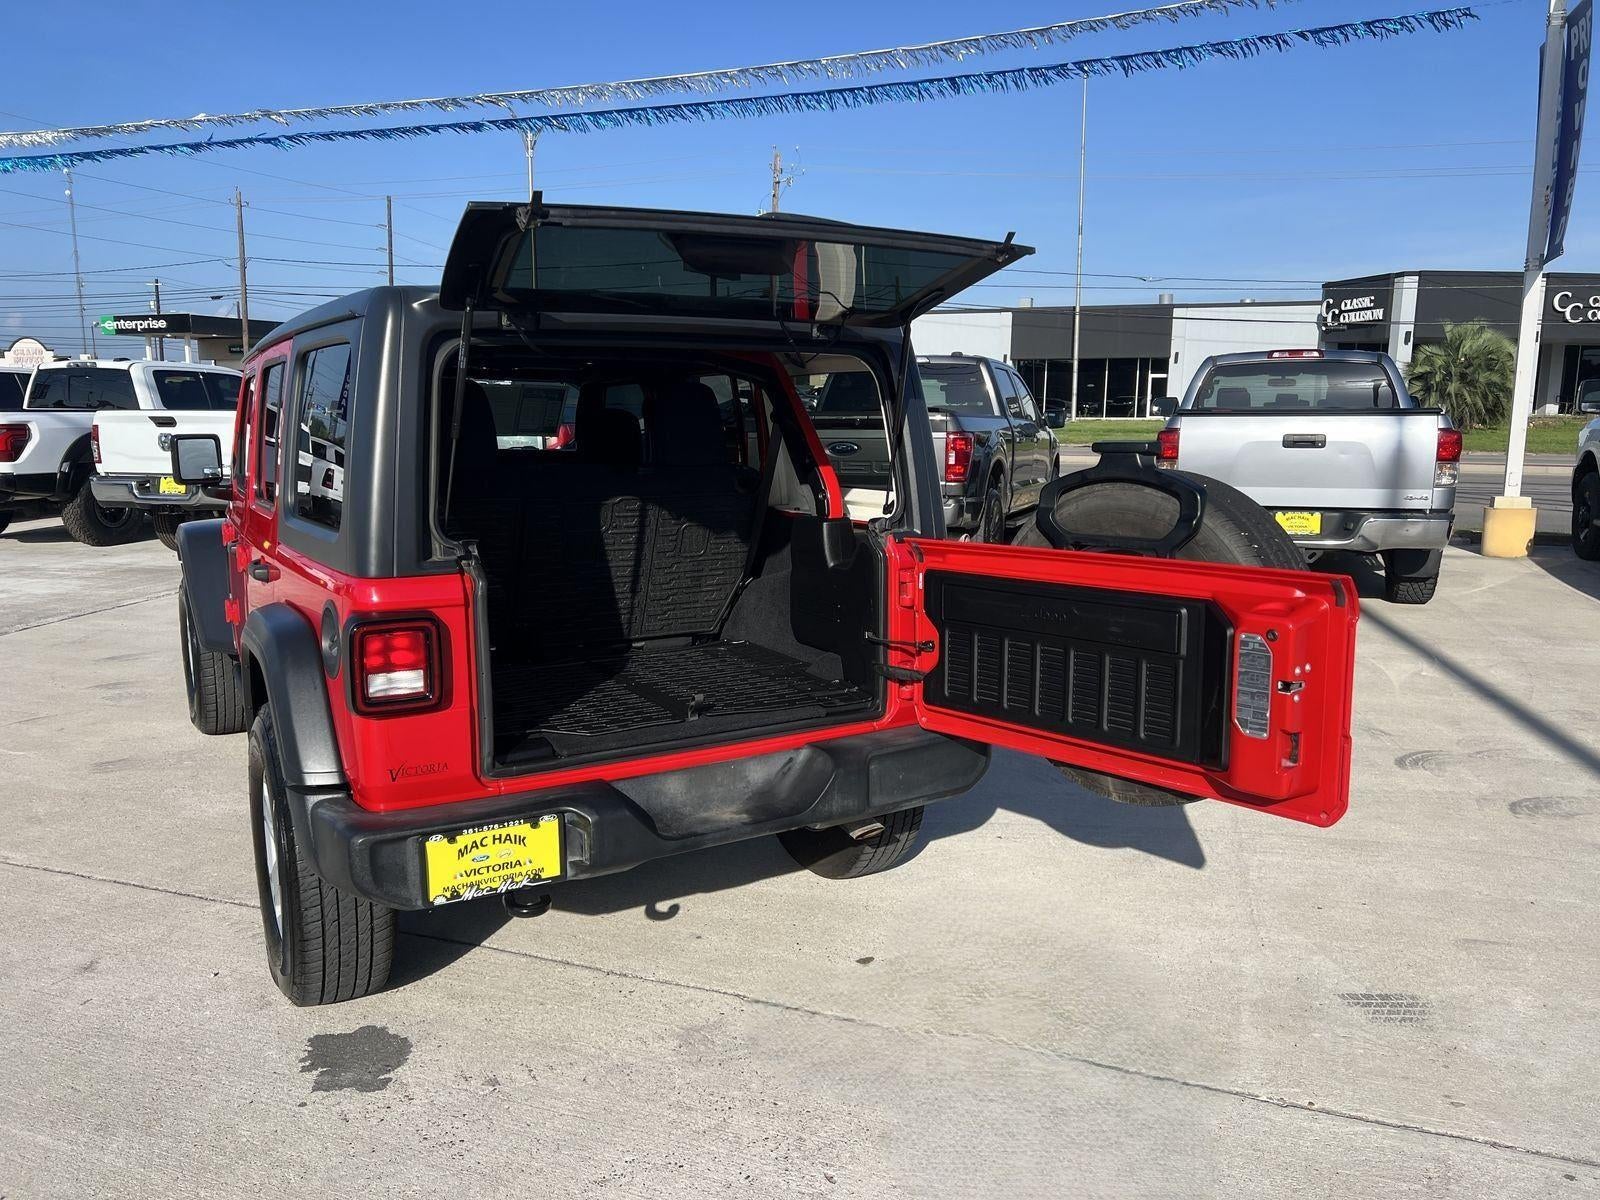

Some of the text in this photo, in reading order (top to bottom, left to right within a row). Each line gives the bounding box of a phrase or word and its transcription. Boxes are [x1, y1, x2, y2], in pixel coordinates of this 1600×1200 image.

[1340, 296, 1375, 310] CLASSIC
[103, 318, 166, 332] enterprise
[388, 760, 449, 783] VICTORIA
[457, 833, 527, 860] MAC HAIK
[464, 859, 522, 878] VICTORIA
[460, 876, 545, 901] Mac Haik
